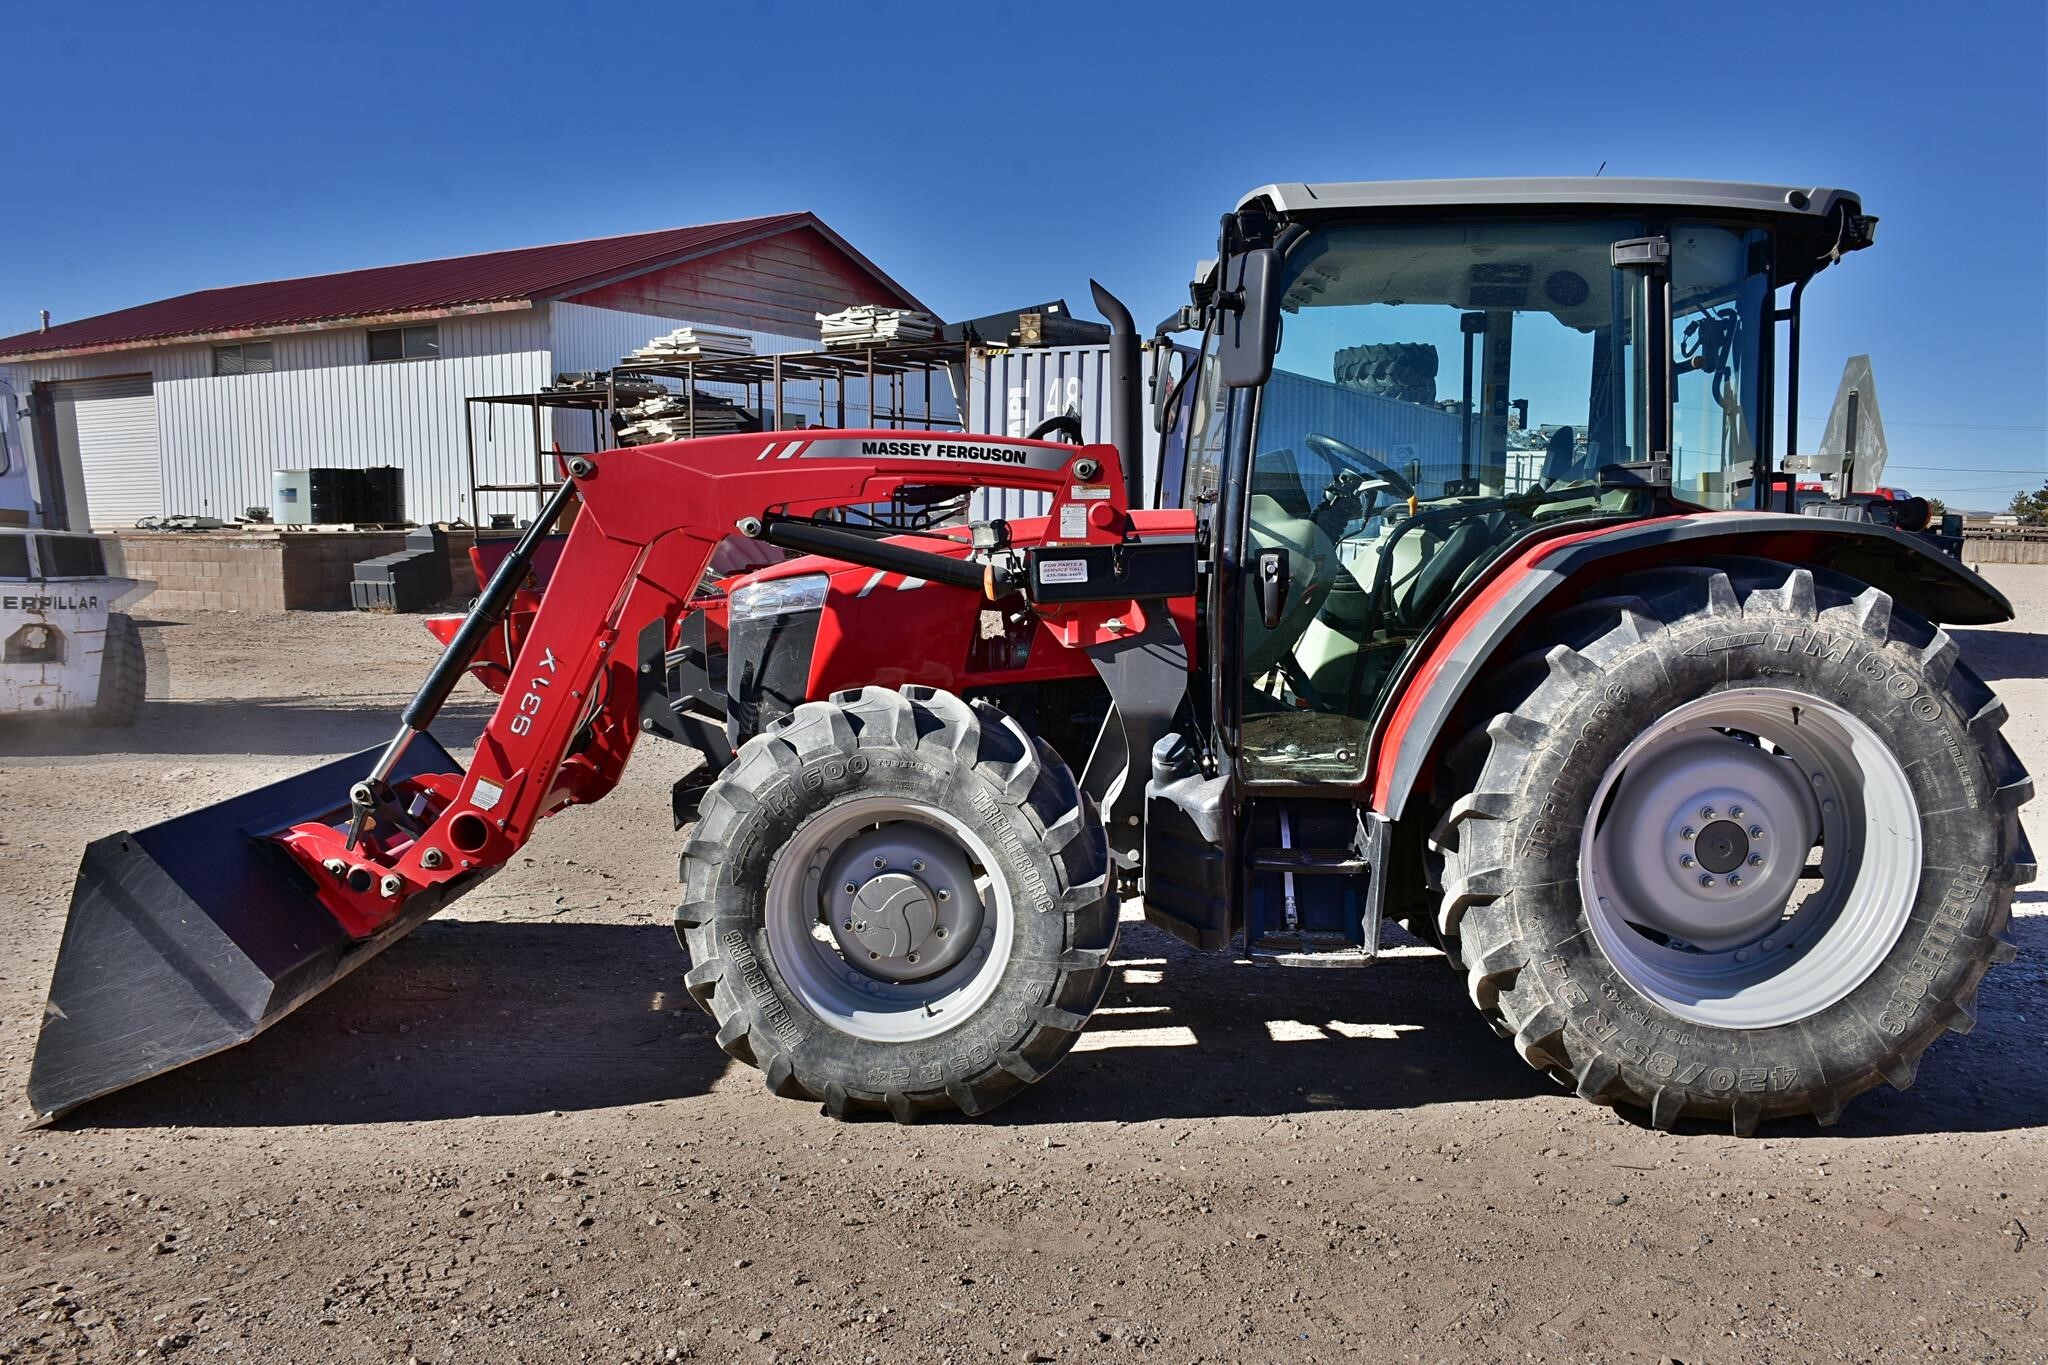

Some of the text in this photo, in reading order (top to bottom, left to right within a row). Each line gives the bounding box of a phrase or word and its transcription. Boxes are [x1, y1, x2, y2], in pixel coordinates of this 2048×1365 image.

[862, 441, 1027, 465] MASSEY FERGUSON
[510, 646, 556, 737] 931X
[1771, 624, 1856, 665] TM
[1856, 651, 1942, 722] 600
[1938, 725, 1979, 810] TUBELESS
[750, 783, 800, 832] TM
[801, 754, 870, 793] 600
[971, 784, 1056, 914] TRELLEBORG
[722, 929, 806, 1055] TRELLEBORG
[1878, 864, 1991, 1038] TRELLEBORG
[949, 981, 1045, 1073] 340/85
[1540, 953, 1799, 1093] 420/85 R 34
[867, 1066, 912, 1087] 24
[919, 1062, 944, 1085] R
